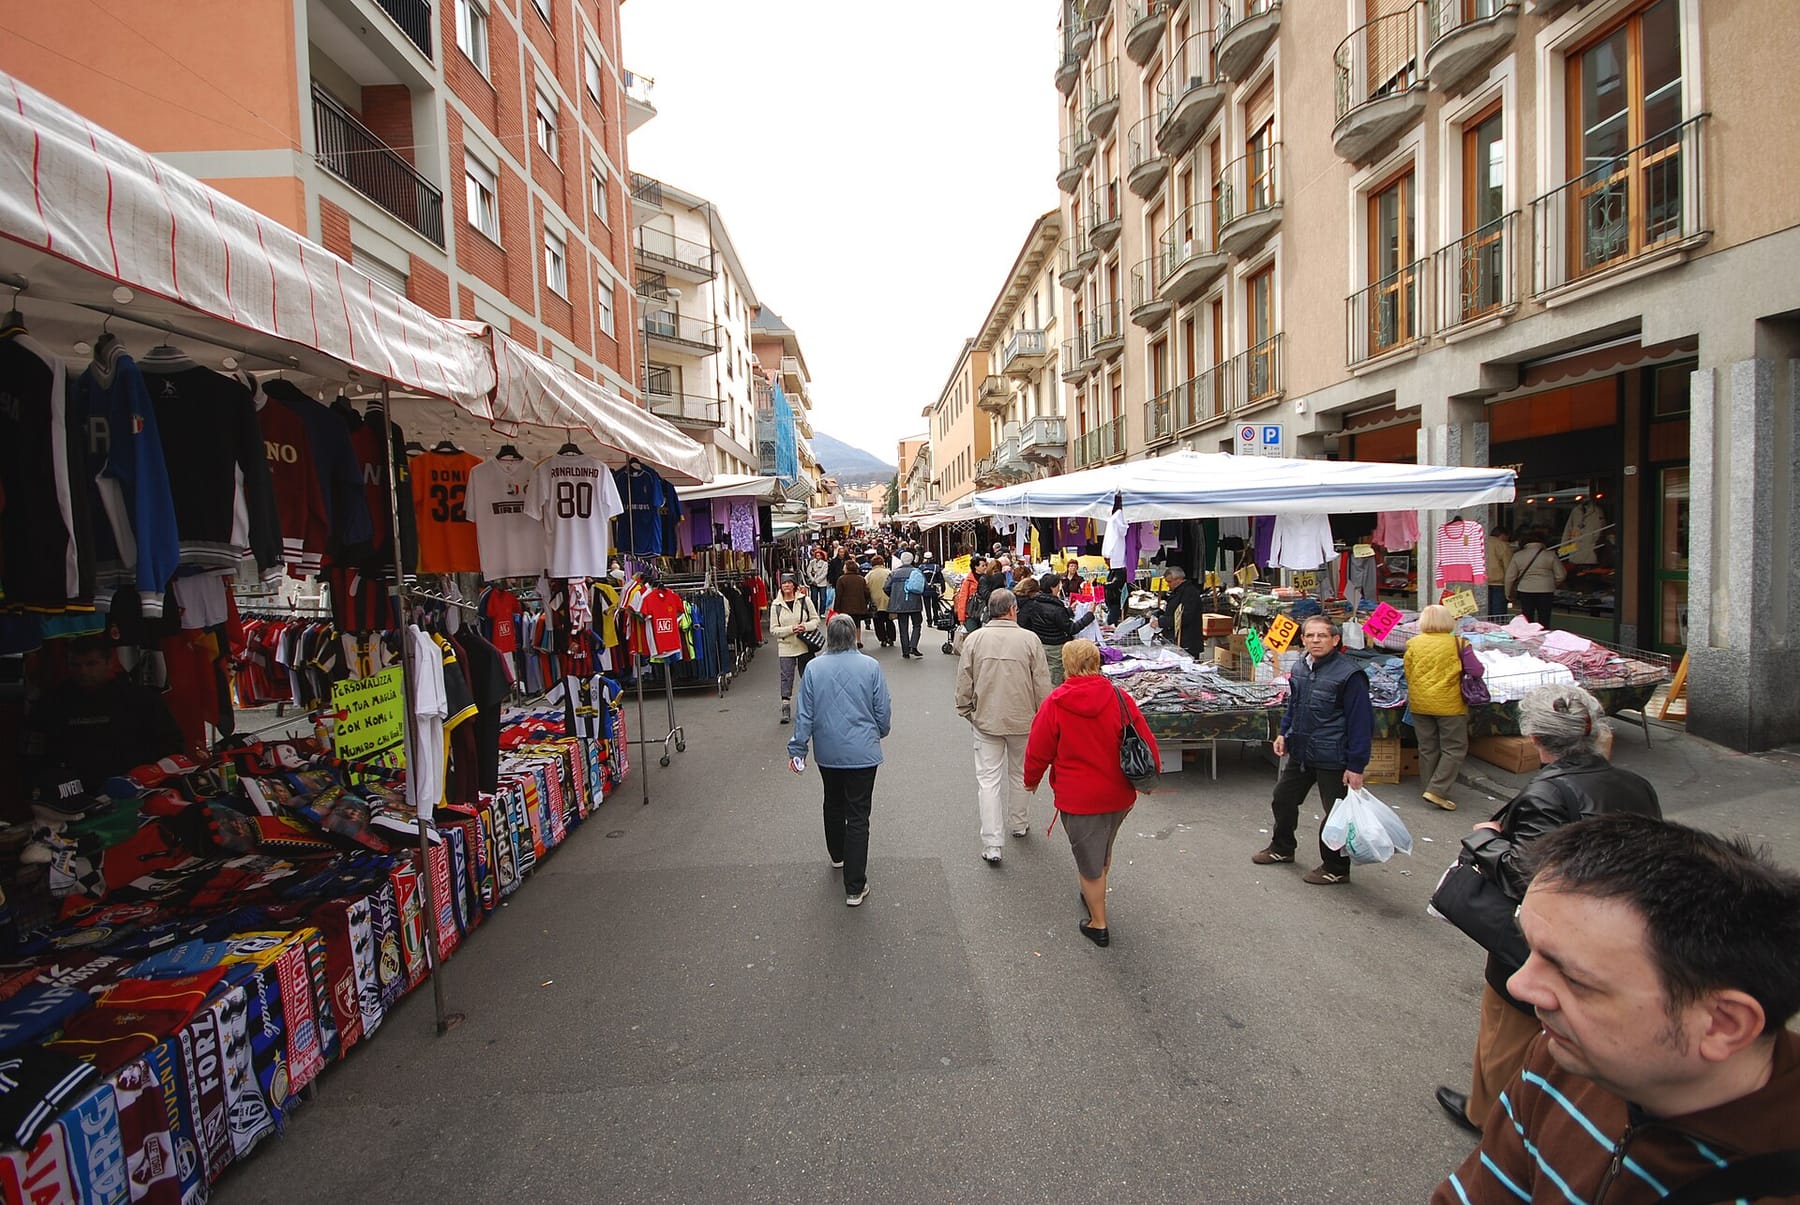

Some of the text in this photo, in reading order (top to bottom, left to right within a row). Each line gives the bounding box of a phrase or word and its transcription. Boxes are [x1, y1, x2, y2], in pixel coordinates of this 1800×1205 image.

[1266, 428, 1276, 443] P
[431, 469, 467, 482] DONI
[551, 466, 599, 479] RONALDINHO
[430, 484, 468, 522] 32
[557, 481, 593, 518] 80
[658, 620, 672, 631] AIG
[1269, 620, 1294, 649] 4,00
[350, 642, 377, 653] ALEX
[352, 700, 370, 712] TUA
[338, 720, 360, 736] CON
